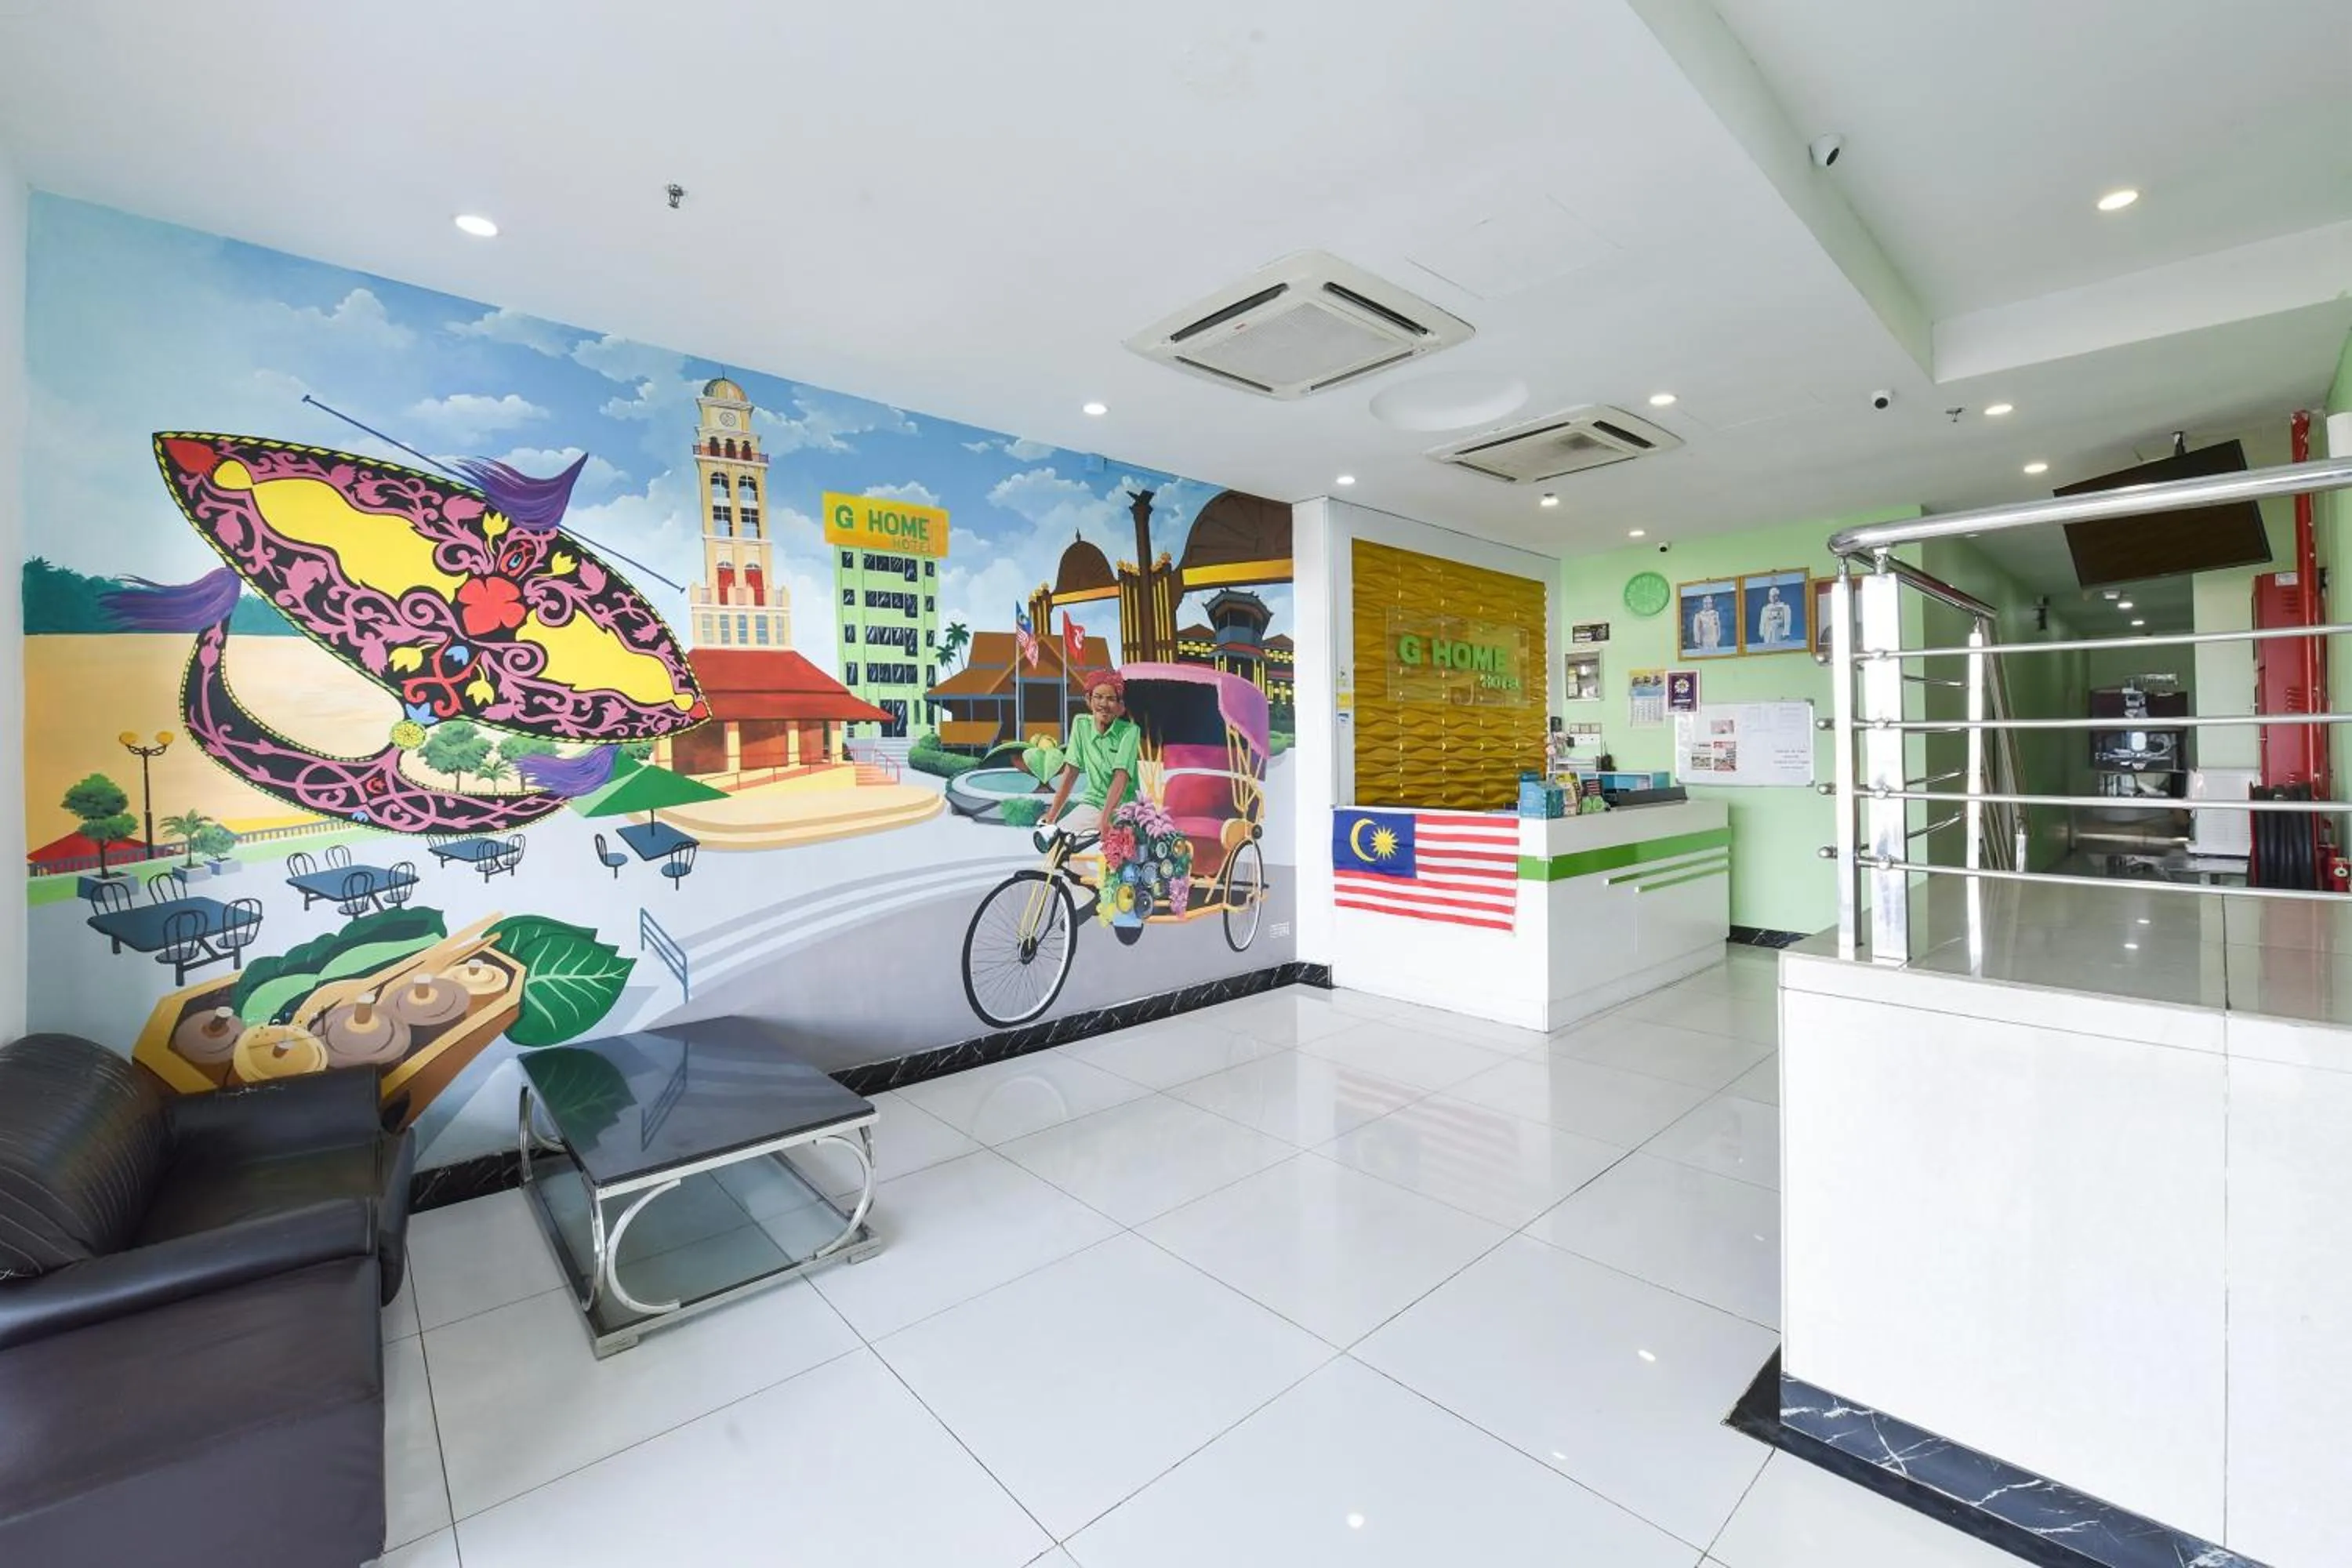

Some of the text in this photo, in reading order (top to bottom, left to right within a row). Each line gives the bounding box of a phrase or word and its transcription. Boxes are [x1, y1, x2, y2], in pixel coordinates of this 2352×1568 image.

[835, 505, 930, 540] G HOME
[1399, 635, 1507, 672] G HOME
